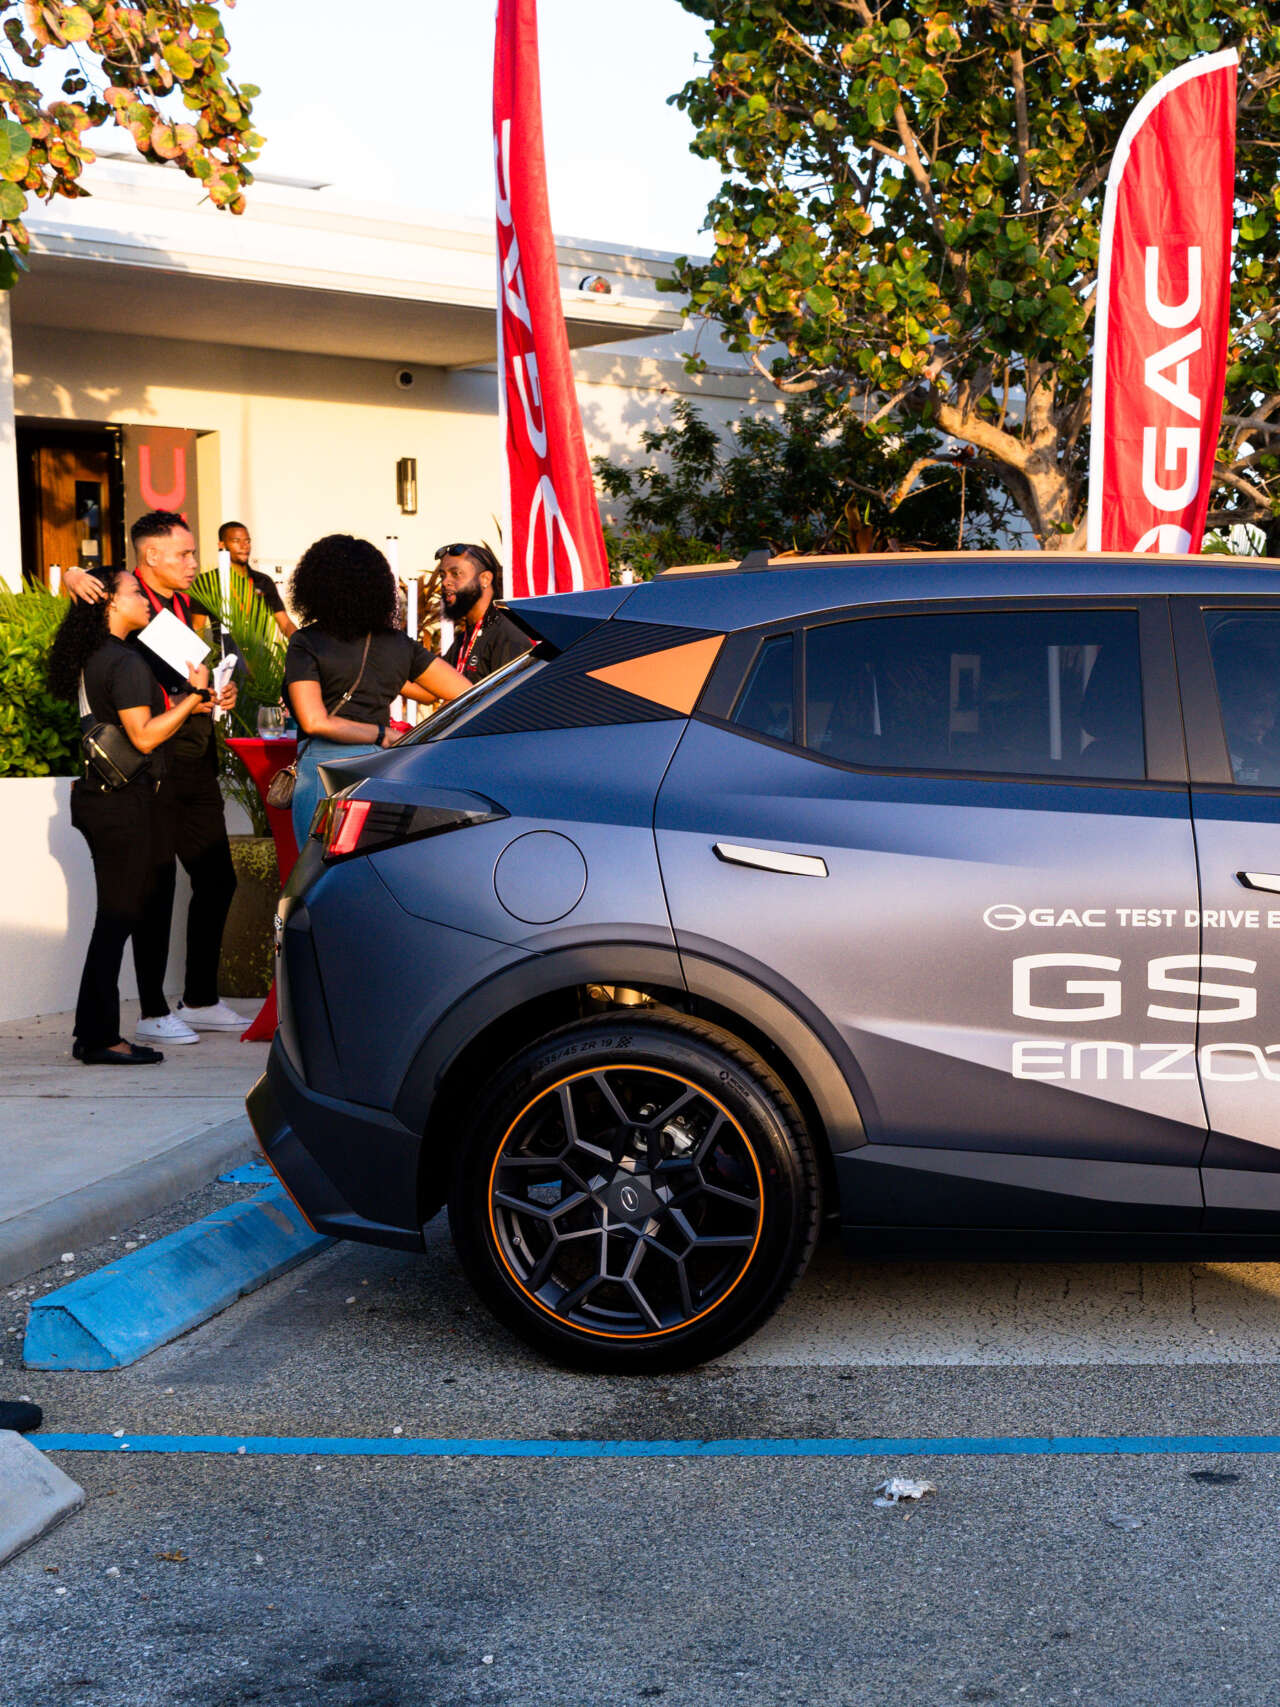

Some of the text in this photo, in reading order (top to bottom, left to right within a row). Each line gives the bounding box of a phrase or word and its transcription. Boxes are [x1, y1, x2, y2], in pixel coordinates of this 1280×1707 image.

[1142, 246, 1201, 511] GAC
[1029, 909, 1106, 928] GAC
[1116, 908, 1177, 928] TEST
[1184, 909, 1259, 929] DRIVE
